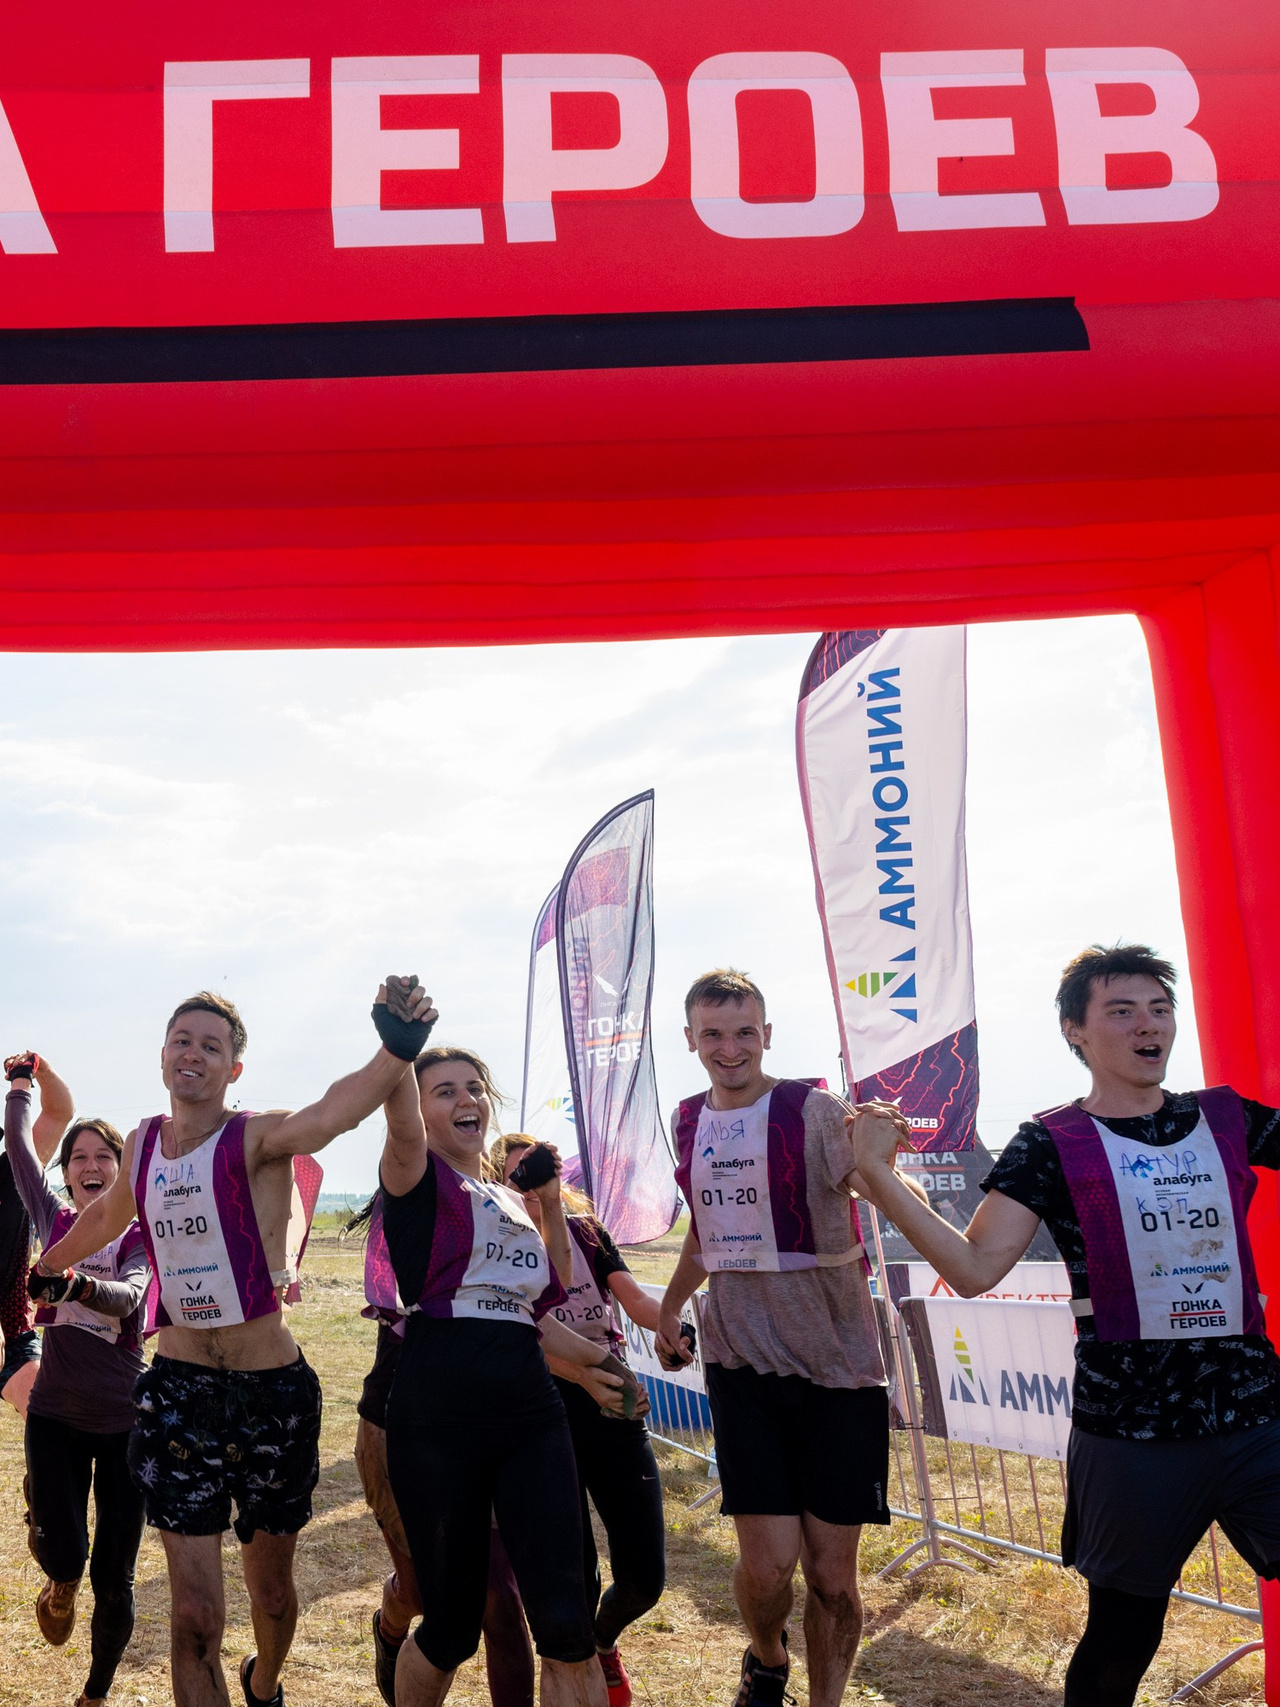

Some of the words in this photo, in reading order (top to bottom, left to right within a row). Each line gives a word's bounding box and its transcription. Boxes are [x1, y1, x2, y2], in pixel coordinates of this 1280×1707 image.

[163, 46, 1220, 253] ГЕРОЕВ
[857, 667, 917, 930] АММОНИЙ
[587, 1041, 641, 1068] ГЕРОЕ
[906, 1117, 938, 1128] РОЕВ
[698, 1118, 745, 1146] ИЛЬЯ
[711, 1158, 755, 1170] алабуга
[1153, 1172, 1212, 1187] алабуга
[163, 1185, 202, 1197] алабуга
[701, 1187, 757, 1206] 01-20
[1141, 1207, 1219, 1232] 01-20
[155, 1216, 208, 1238] 01-20
[722, 1232, 762, 1242] АММОНИЙ
[486, 1242, 538, 1269] 01-20
[177, 1263, 219, 1276] АММОНИЙ
[1172, 1262, 1229, 1276] АММОНИЙ
[567, 1283, 592, 1295] абуга
[180, 1295, 216, 1307] ГОНКА
[478, 1300, 520, 1314] ГЕРОЕВ
[1172, 1299, 1222, 1312] ГОНКА
[182, 1309, 222, 1321] ГЕРОЕВ
[555, 1305, 604, 1323] 01-20
[1170, 1315, 1227, 1329] ГЕРОЕВ
